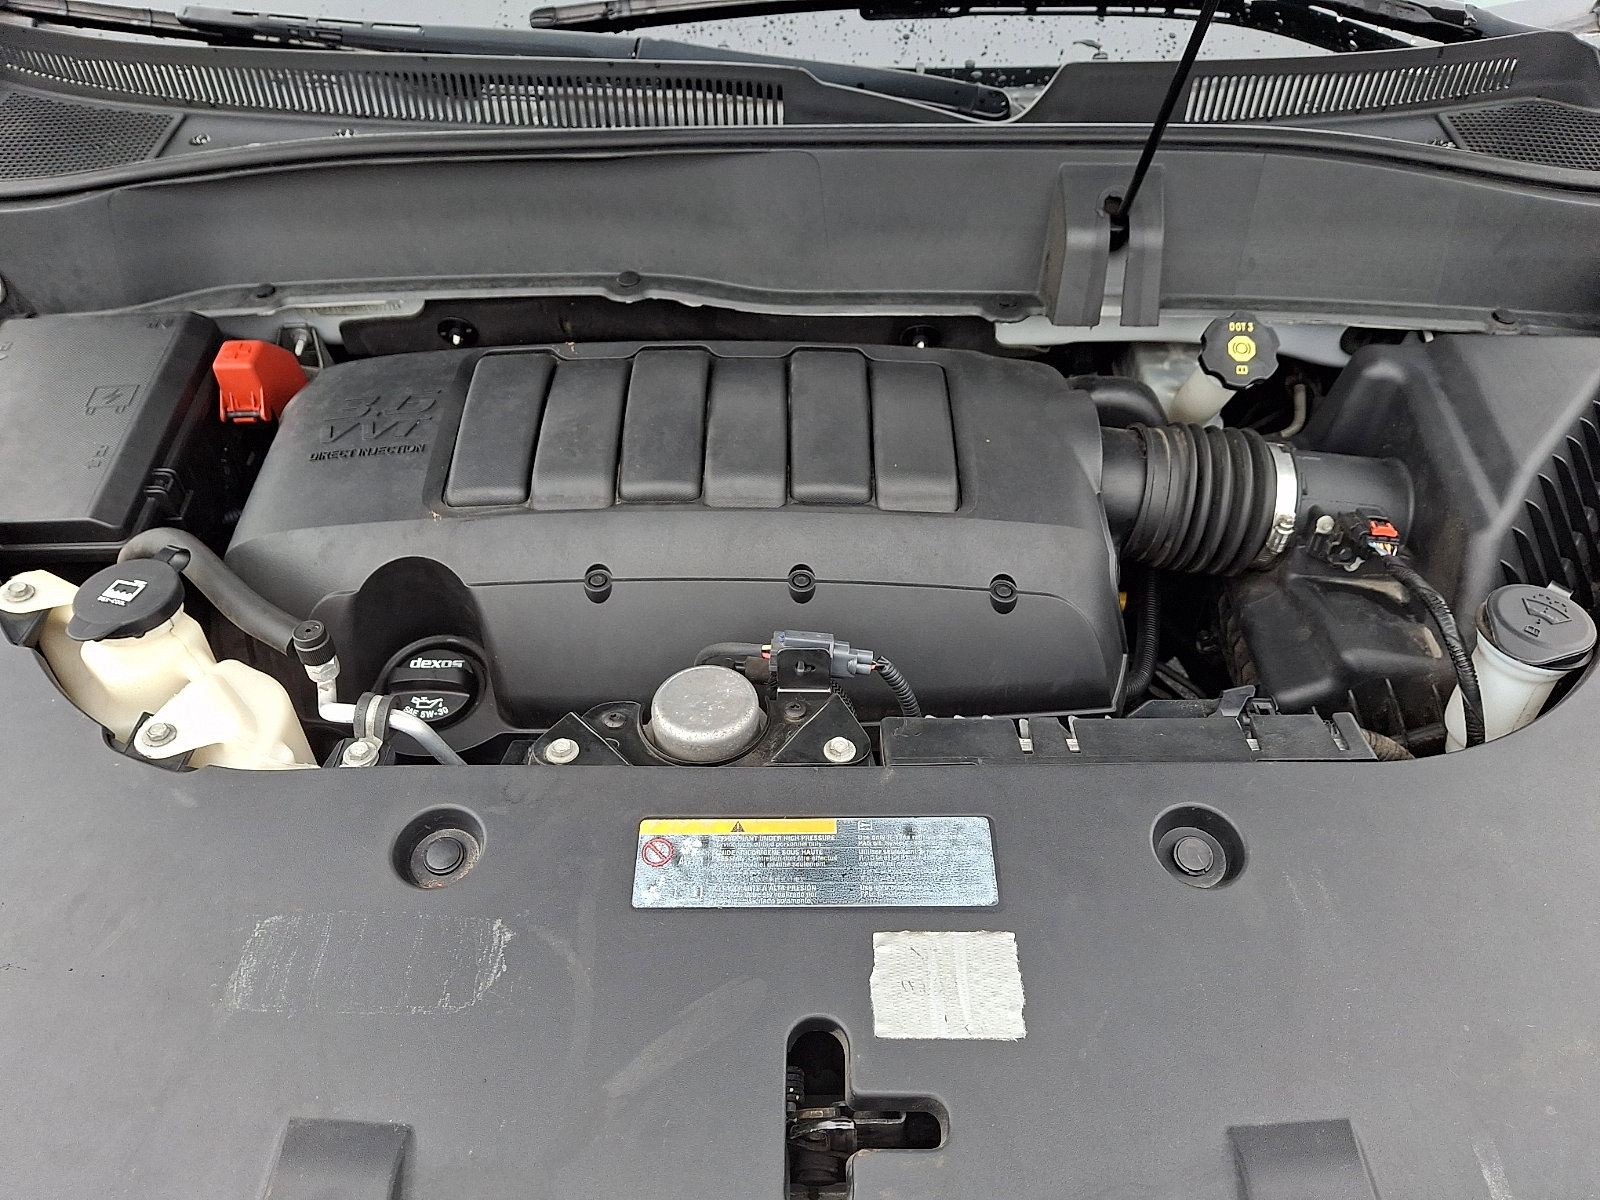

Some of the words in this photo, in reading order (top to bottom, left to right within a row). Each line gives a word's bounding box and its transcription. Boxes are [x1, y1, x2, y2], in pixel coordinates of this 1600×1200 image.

[1229, 321, 1246, 332] DOT
[1247, 321, 1255, 333] 3
[309, 448, 357, 462] DIRECT
[358, 443, 426, 457] INJECTION
[409, 657, 465, 669] dexos
[403, 705, 419, 717] SAE
[420, 706, 449, 719] 5W-30
